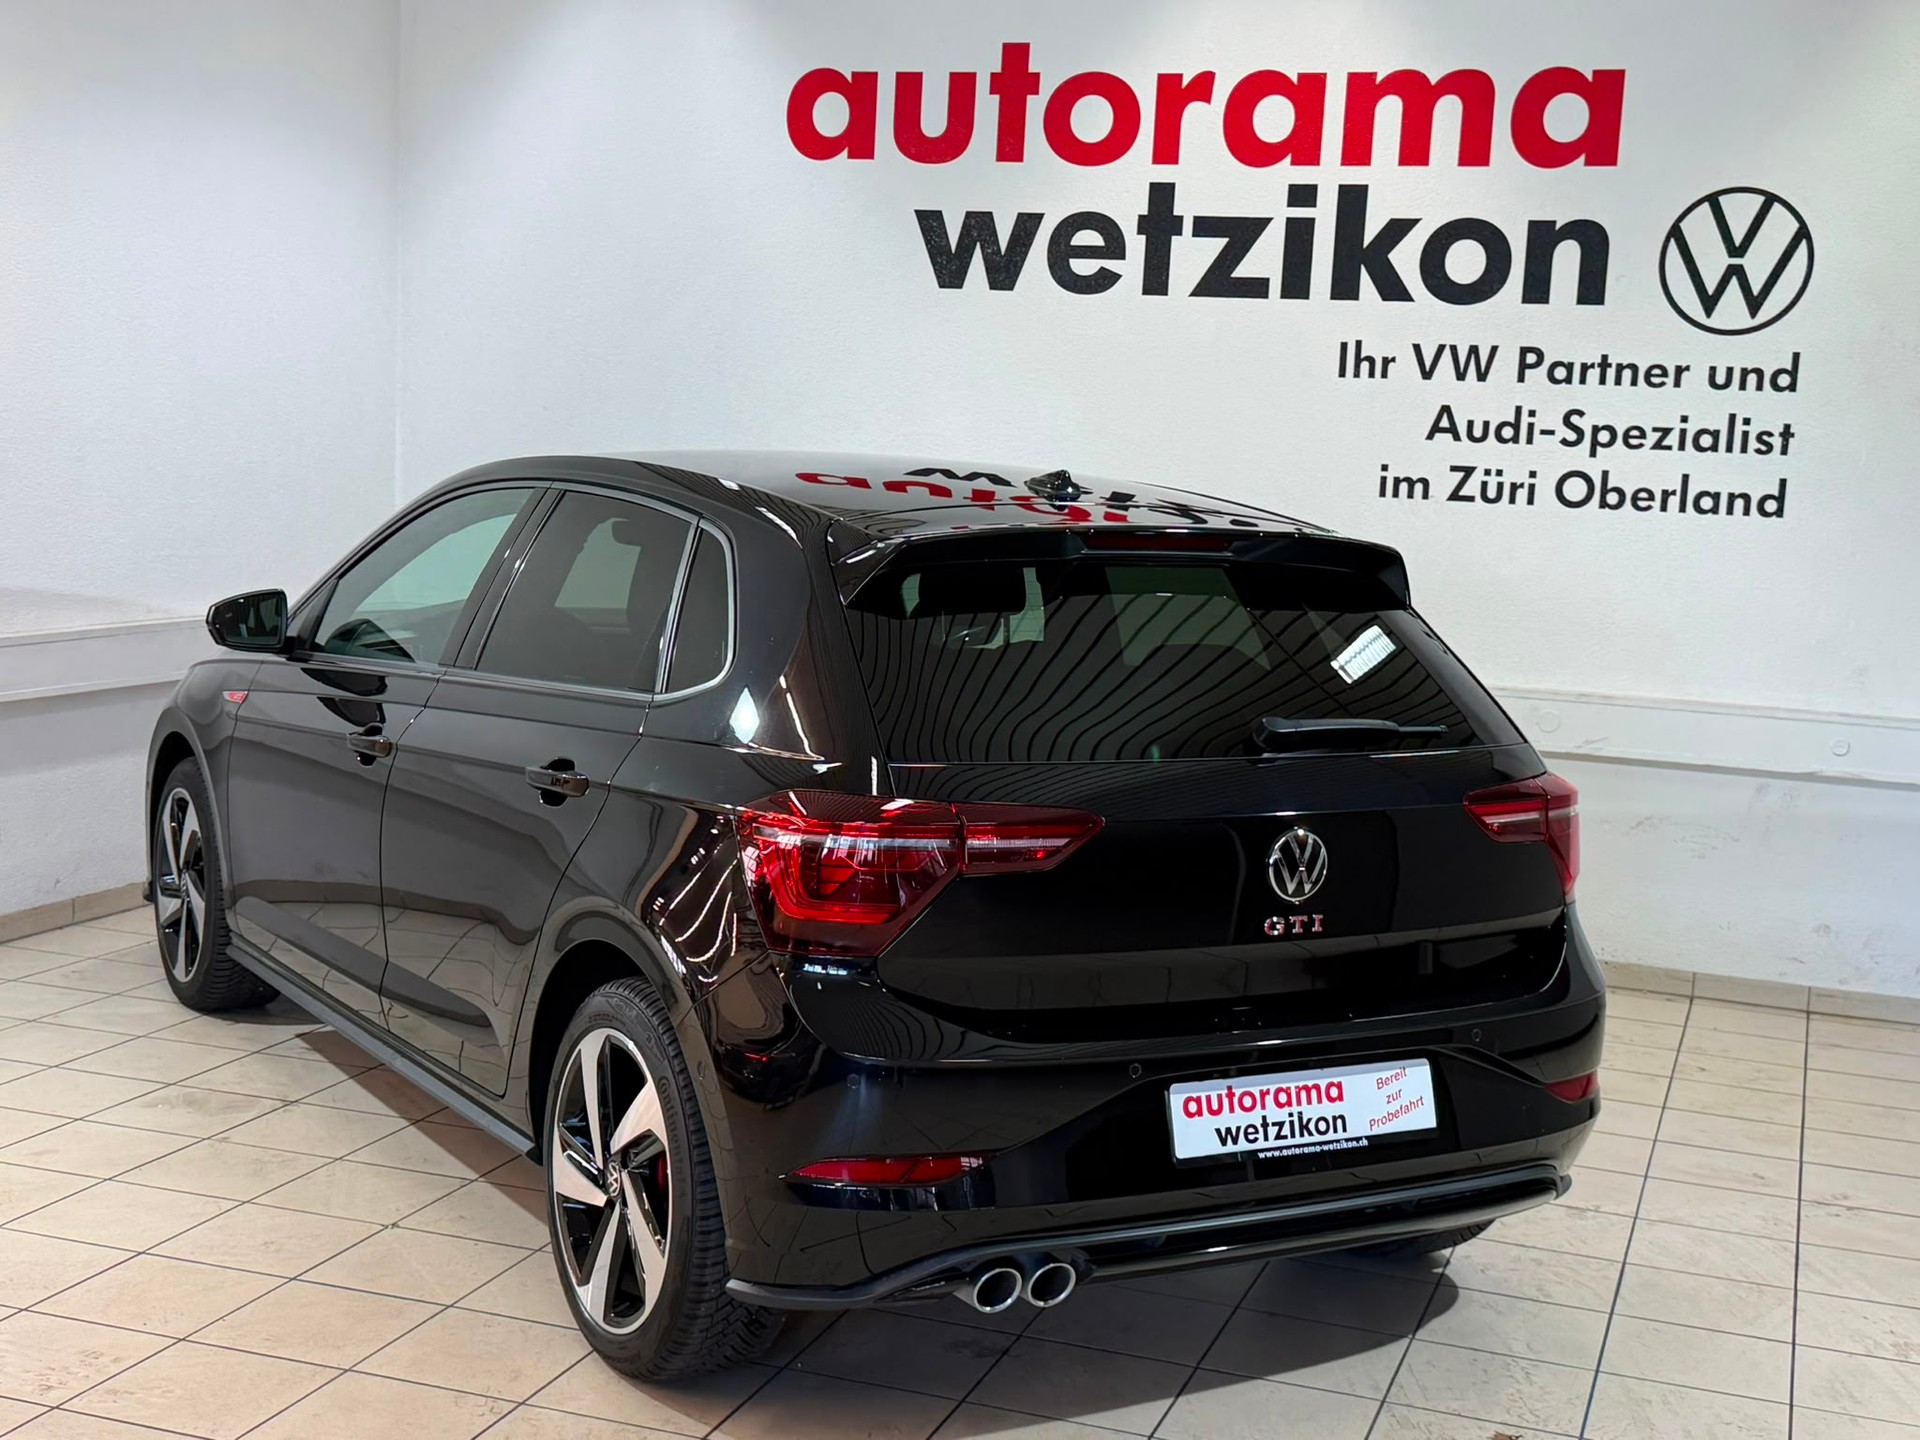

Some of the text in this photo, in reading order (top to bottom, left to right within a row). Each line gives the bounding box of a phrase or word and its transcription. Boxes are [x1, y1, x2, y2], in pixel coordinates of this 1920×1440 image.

[787, 43, 1626, 170] autorama
[914, 182, 1609, 305] wetzikon
[1659, 187, 1814, 336] VW
[1339, 340, 1800, 392] Ihr VW Partner und
[1426, 405, 1794, 458] Audi-Spezialist
[1380, 464, 1787, 518] im Züri Oberland
[1264, 914, 1323, 935] GTI
[1376, 1066, 1408, 1090] Bereit
[1386, 1087, 1403, 1105] zur
[1182, 1081, 1345, 1119] autorama
[1368, 1095, 1425, 1131] Probefahrt
[1214, 1111, 1348, 1147] wetzikon
[1257, 1138, 1369, 1159] www.autorama-wetzikon.ch
